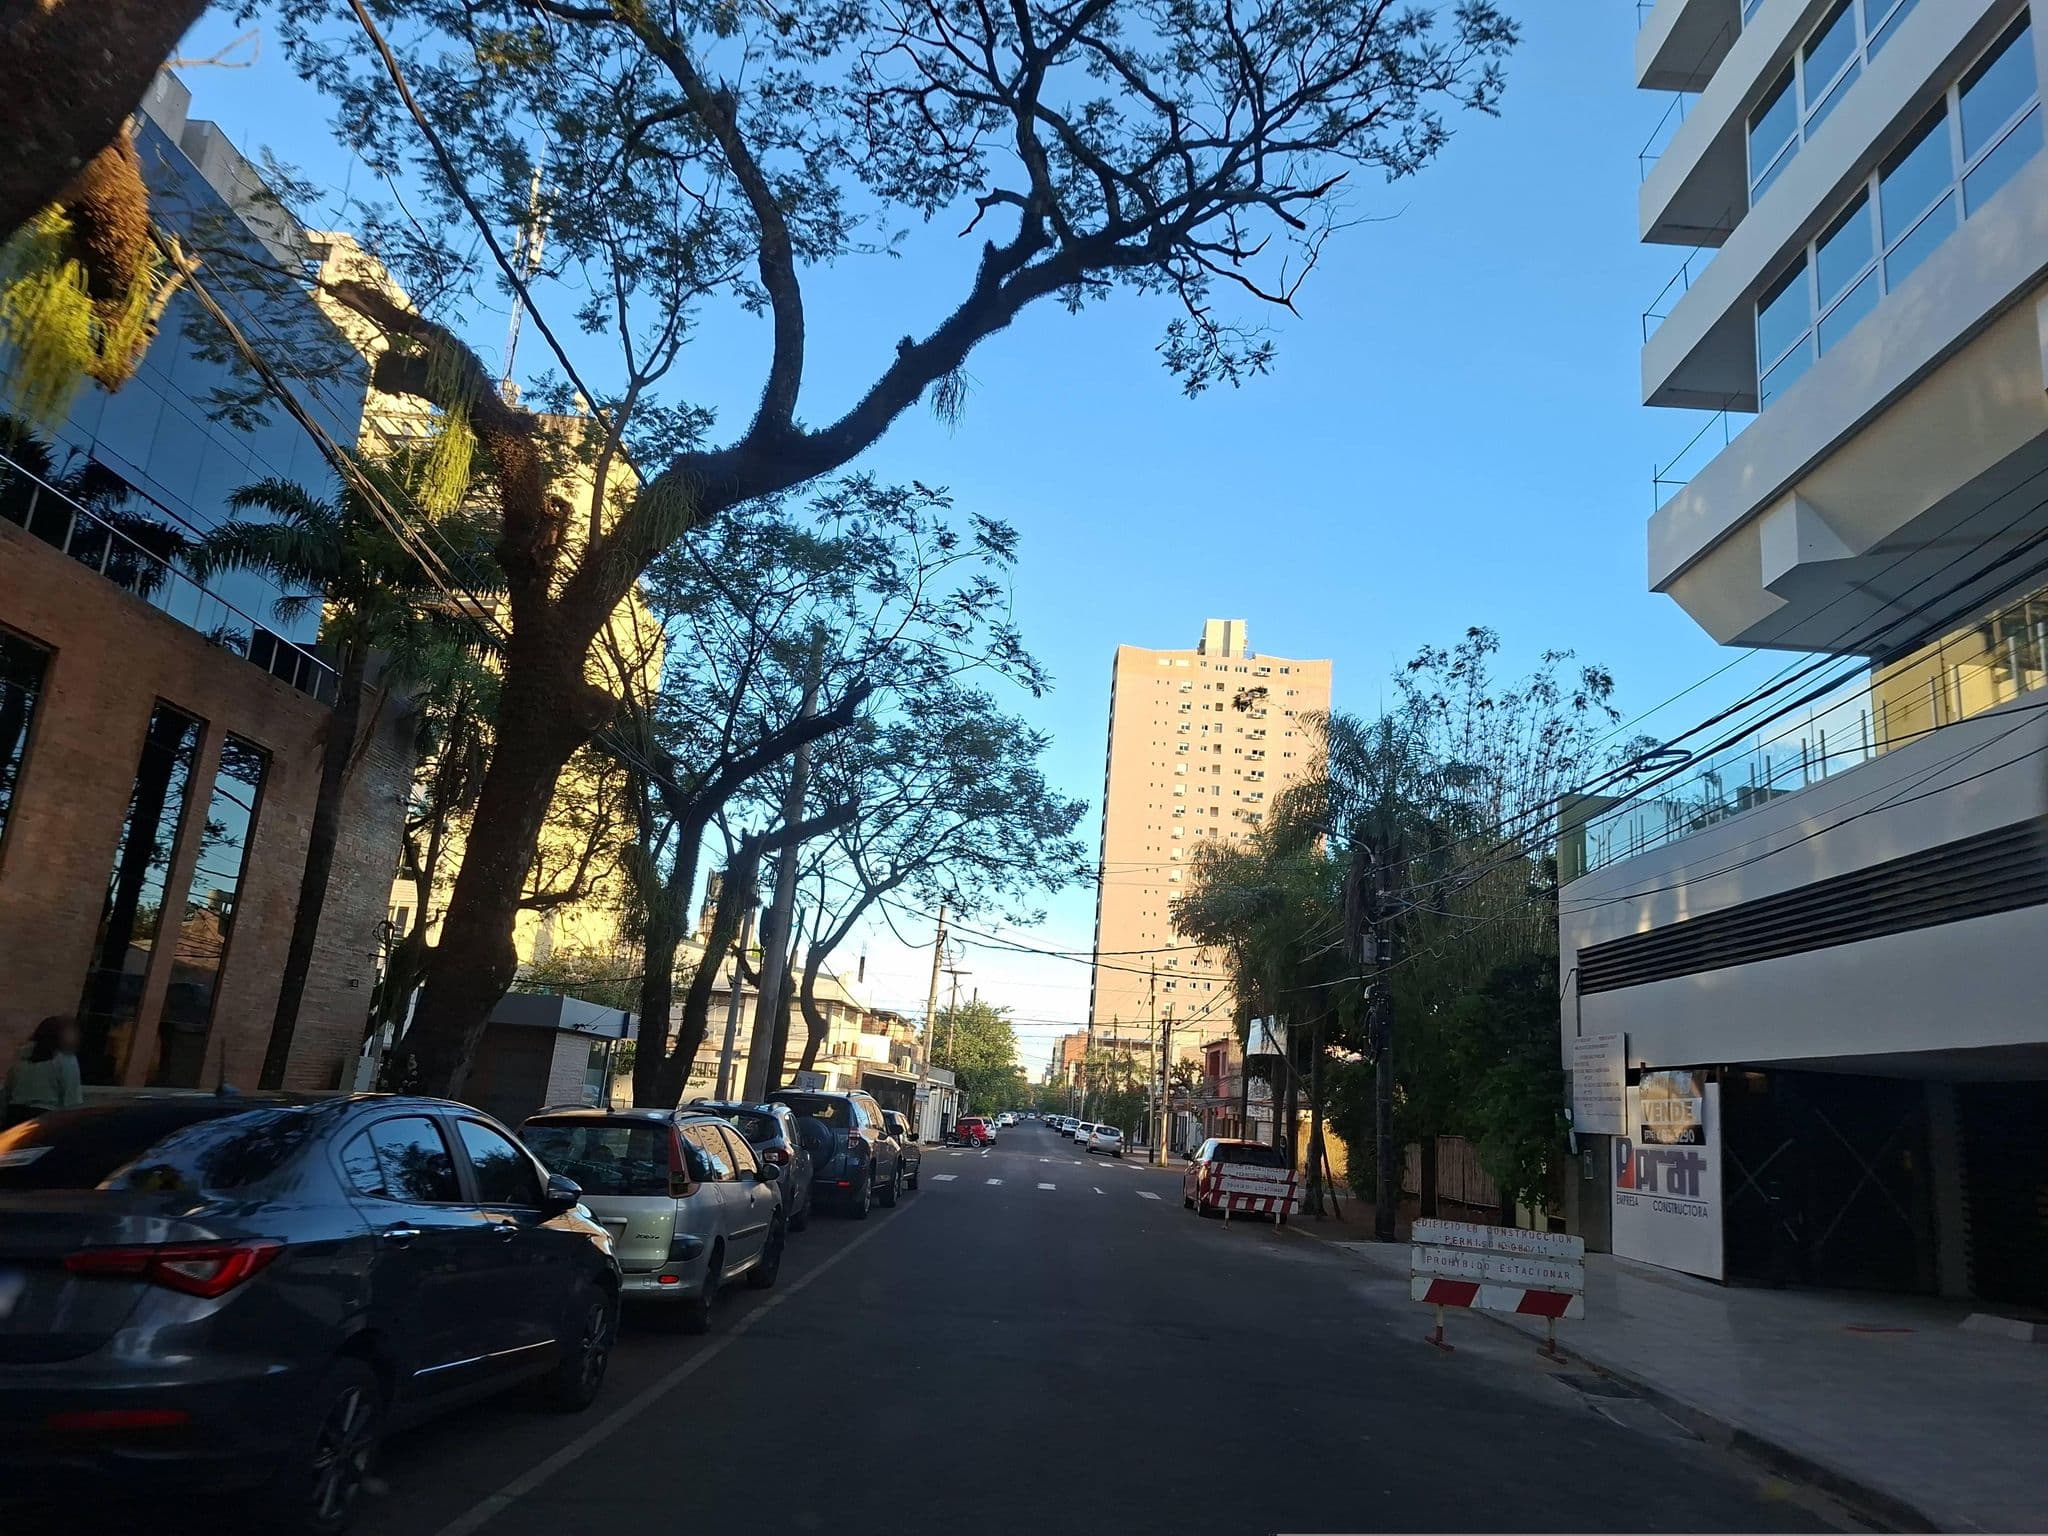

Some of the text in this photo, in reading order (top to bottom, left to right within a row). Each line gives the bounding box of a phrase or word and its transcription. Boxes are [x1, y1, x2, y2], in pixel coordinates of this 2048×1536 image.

[1616, 1194, 1709, 1218] EMPRESA CONSTRUCTORA
[1416, 1219, 1461, 1231] EDIFICIO
[1487, 1226, 1573, 1244] CONSTRUCCION
[1499, 1263, 1571, 1280] ESTACIONAR
